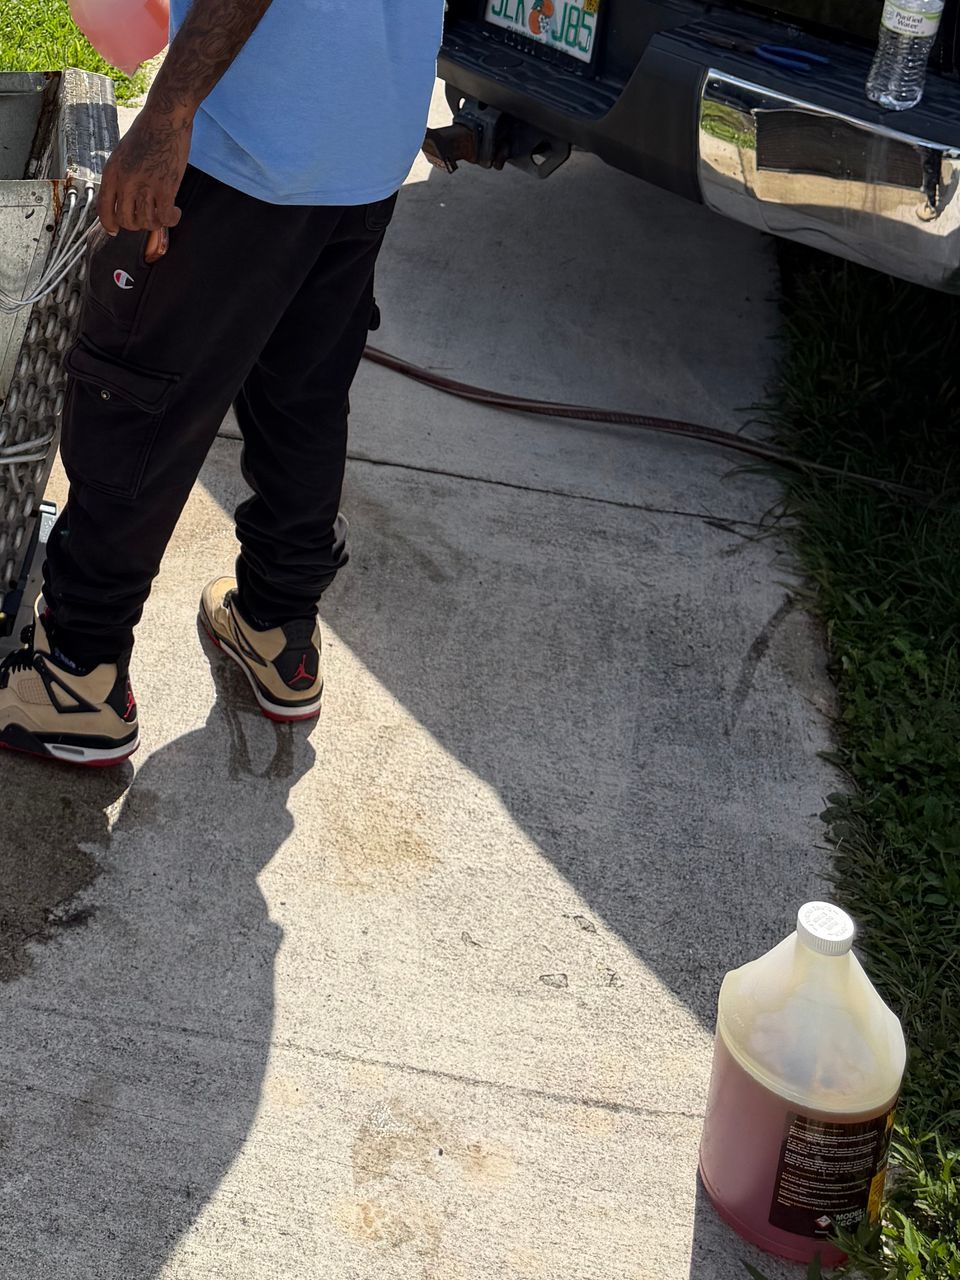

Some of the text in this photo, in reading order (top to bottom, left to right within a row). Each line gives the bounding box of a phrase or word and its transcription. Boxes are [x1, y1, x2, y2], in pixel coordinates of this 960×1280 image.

[895, 10, 924, 24] Purified
[551, 1, 596, 54] J85
[897, 19, 920, 30] Water
